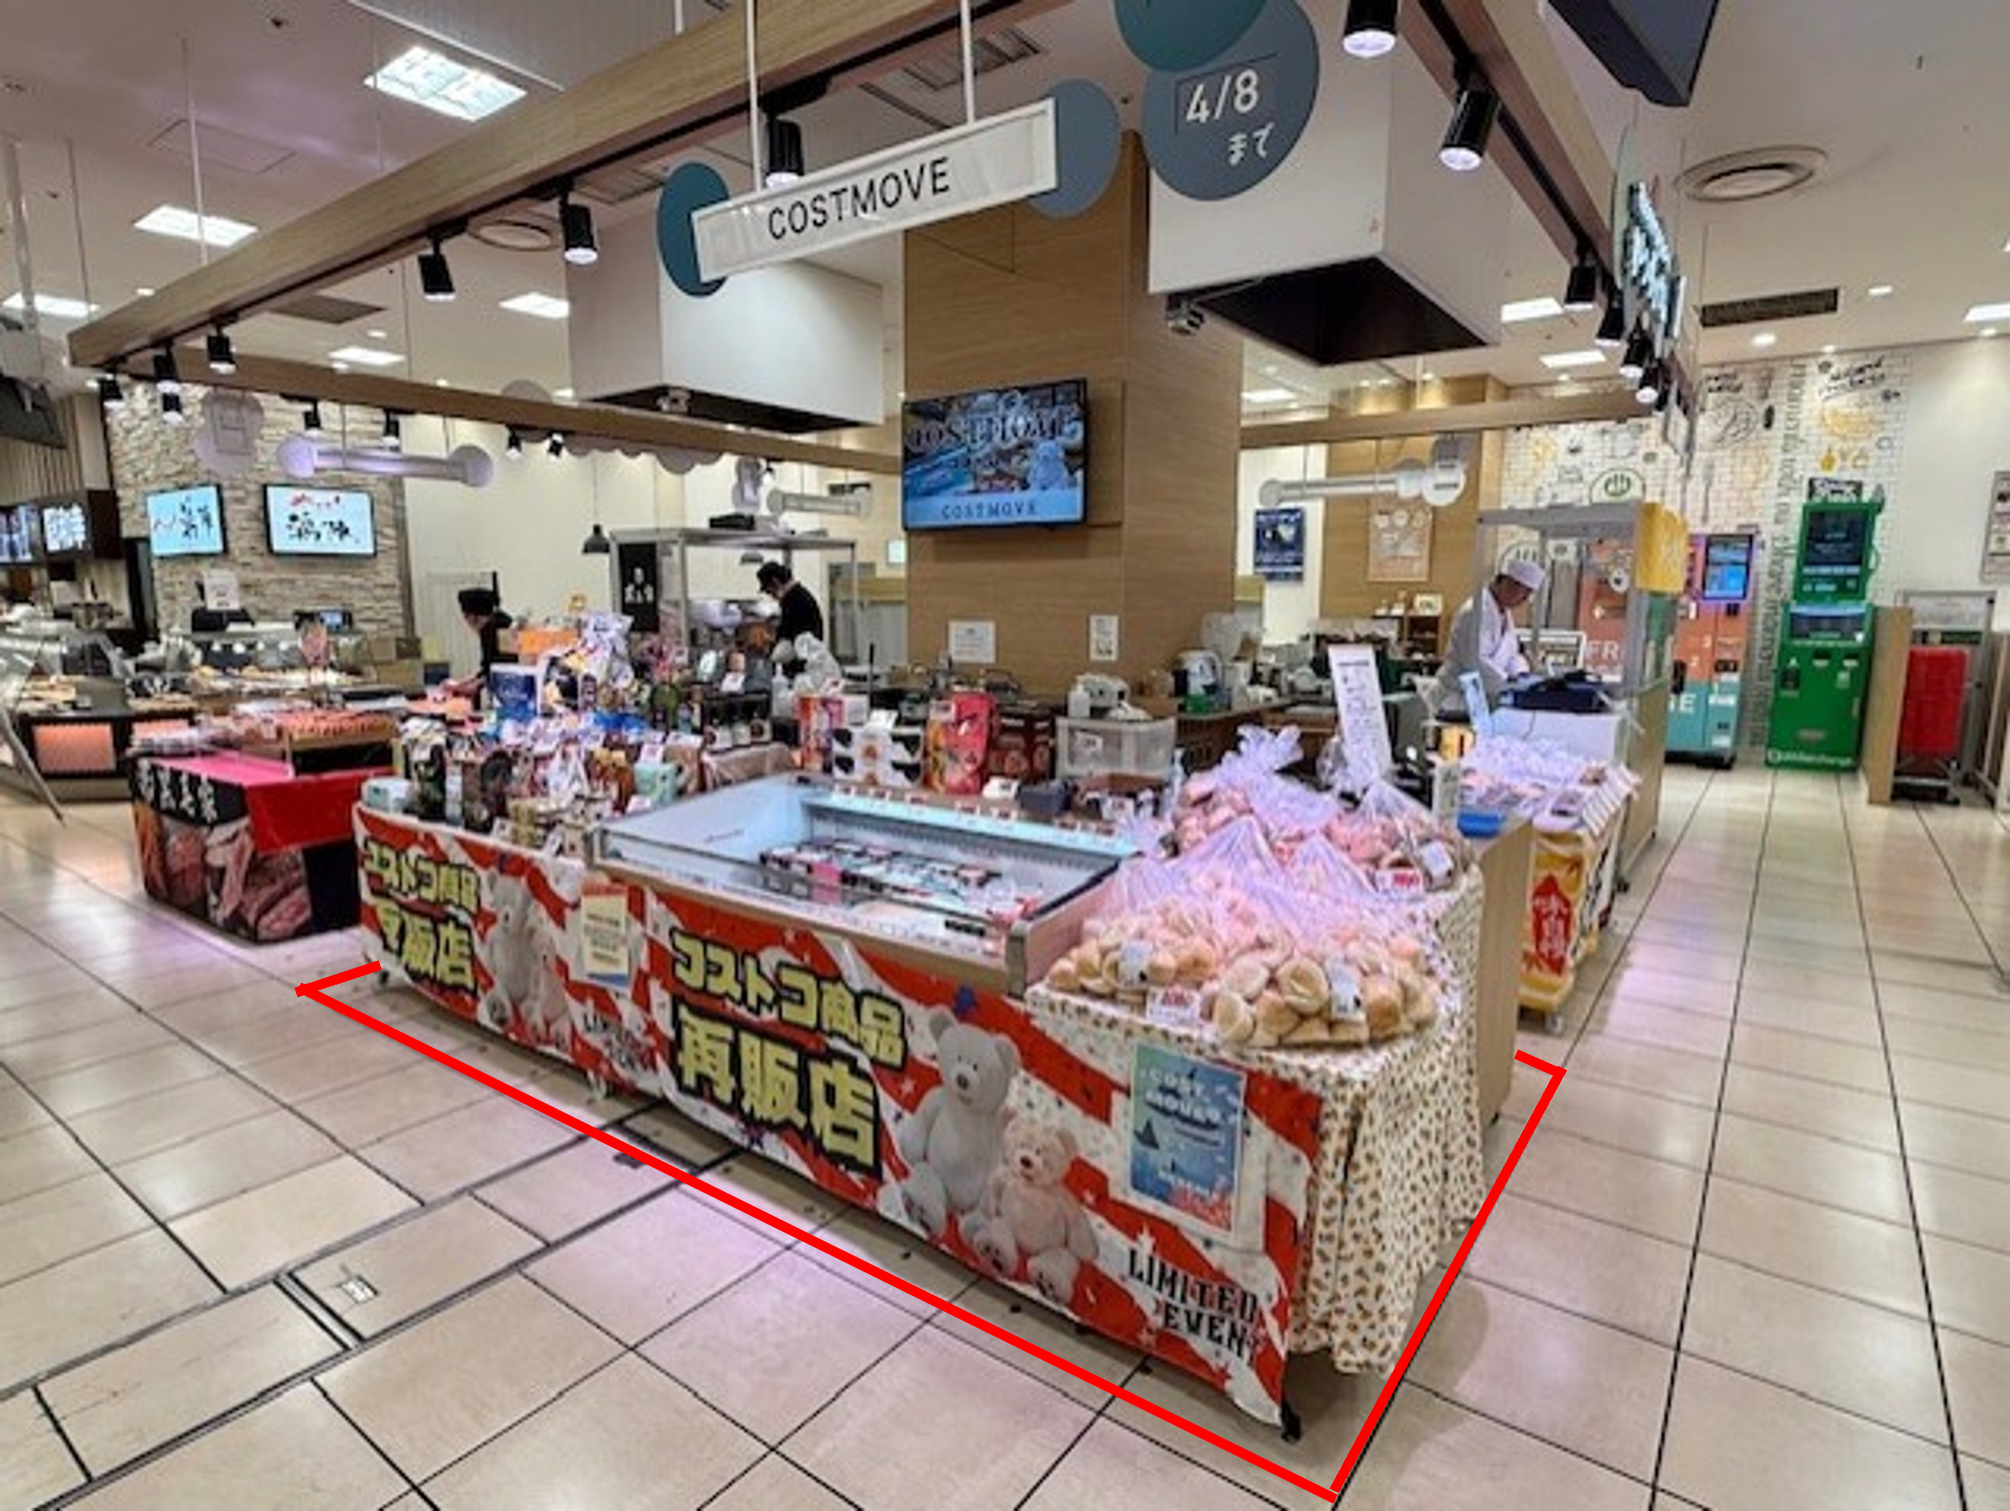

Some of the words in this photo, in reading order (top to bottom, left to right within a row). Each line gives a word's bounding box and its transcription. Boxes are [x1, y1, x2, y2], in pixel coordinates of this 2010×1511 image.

[1185, 68, 1259, 124] 4/8
[1228, 121, 1276, 166] まで
[766, 156, 951, 241] COSTMOVE
[941, 500, 1039, 521] COSTMOVE
[671, 932, 906, 1068] コストコ商品
[677, 1003, 880, 1172] 再販店
[1129, 1249, 1259, 1324] LIMITED
[1164, 1303, 1258, 1368] EVENT
